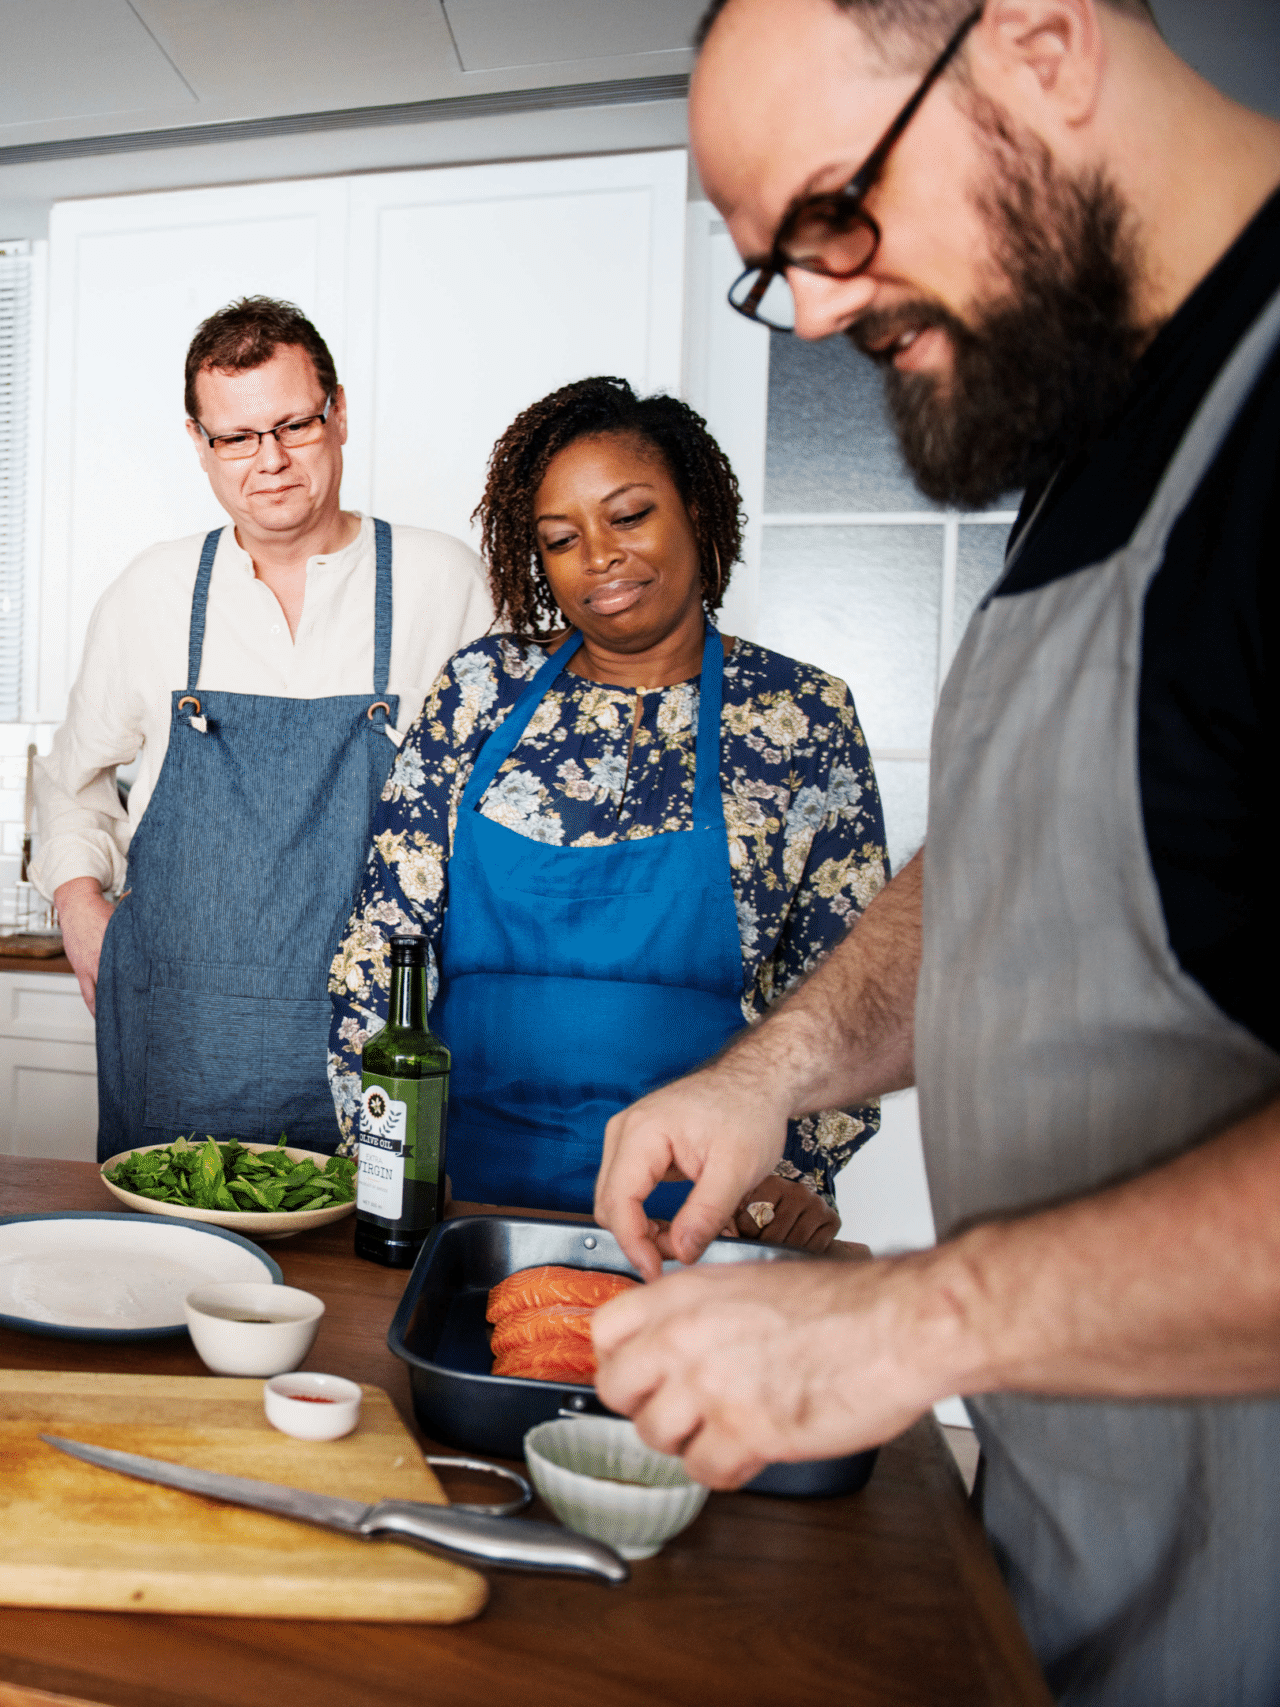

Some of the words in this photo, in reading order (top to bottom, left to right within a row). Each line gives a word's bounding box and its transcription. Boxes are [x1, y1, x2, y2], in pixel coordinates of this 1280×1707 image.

[360, 1133, 379, 1146] OLIVE
[379, 1139, 393, 1150] OIL
[365, 1153, 384, 1165] EXTRA
